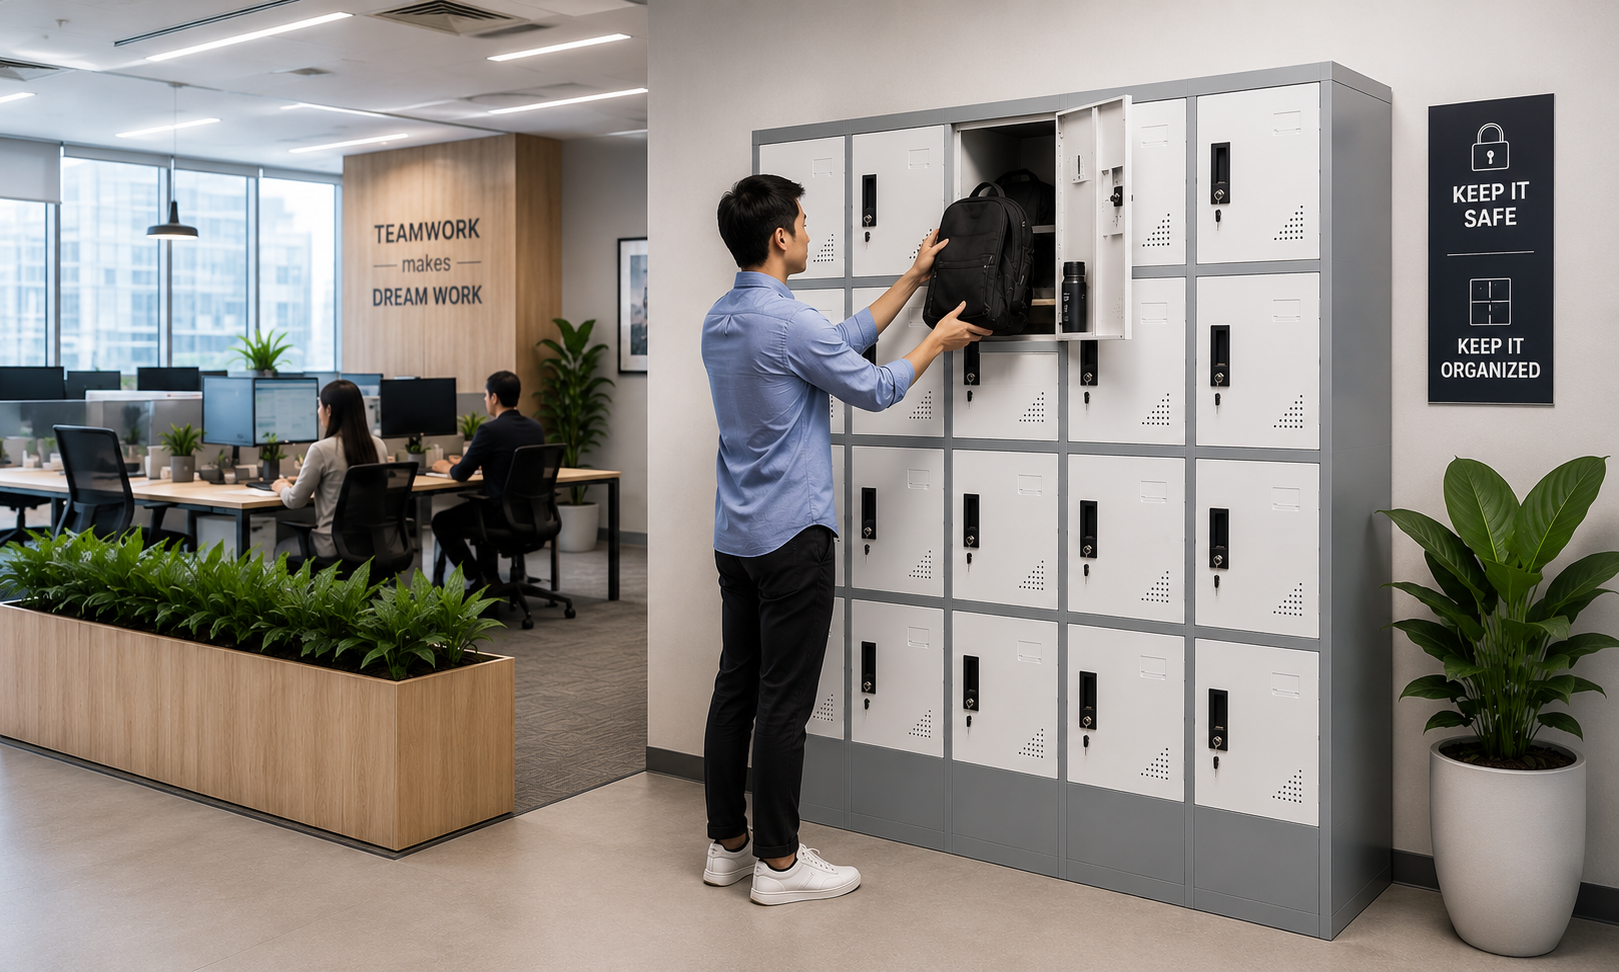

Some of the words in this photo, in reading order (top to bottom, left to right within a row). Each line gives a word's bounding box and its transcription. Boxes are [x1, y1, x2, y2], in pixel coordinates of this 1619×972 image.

[1453, 183, 1505, 203] KEEP
[1511, 181, 1530, 200] IT
[1464, 207, 1517, 228] SAFE
[374, 217, 480, 244] TEAMWORK
[402, 254, 451, 273] makes
[373, 287, 428, 307] DREAM
[433, 285, 483, 305] WORK
[1457, 337, 1502, 355] KEEP
[1508, 337, 1525, 354] IT
[1441, 361, 1541, 379] ORGANIZED
